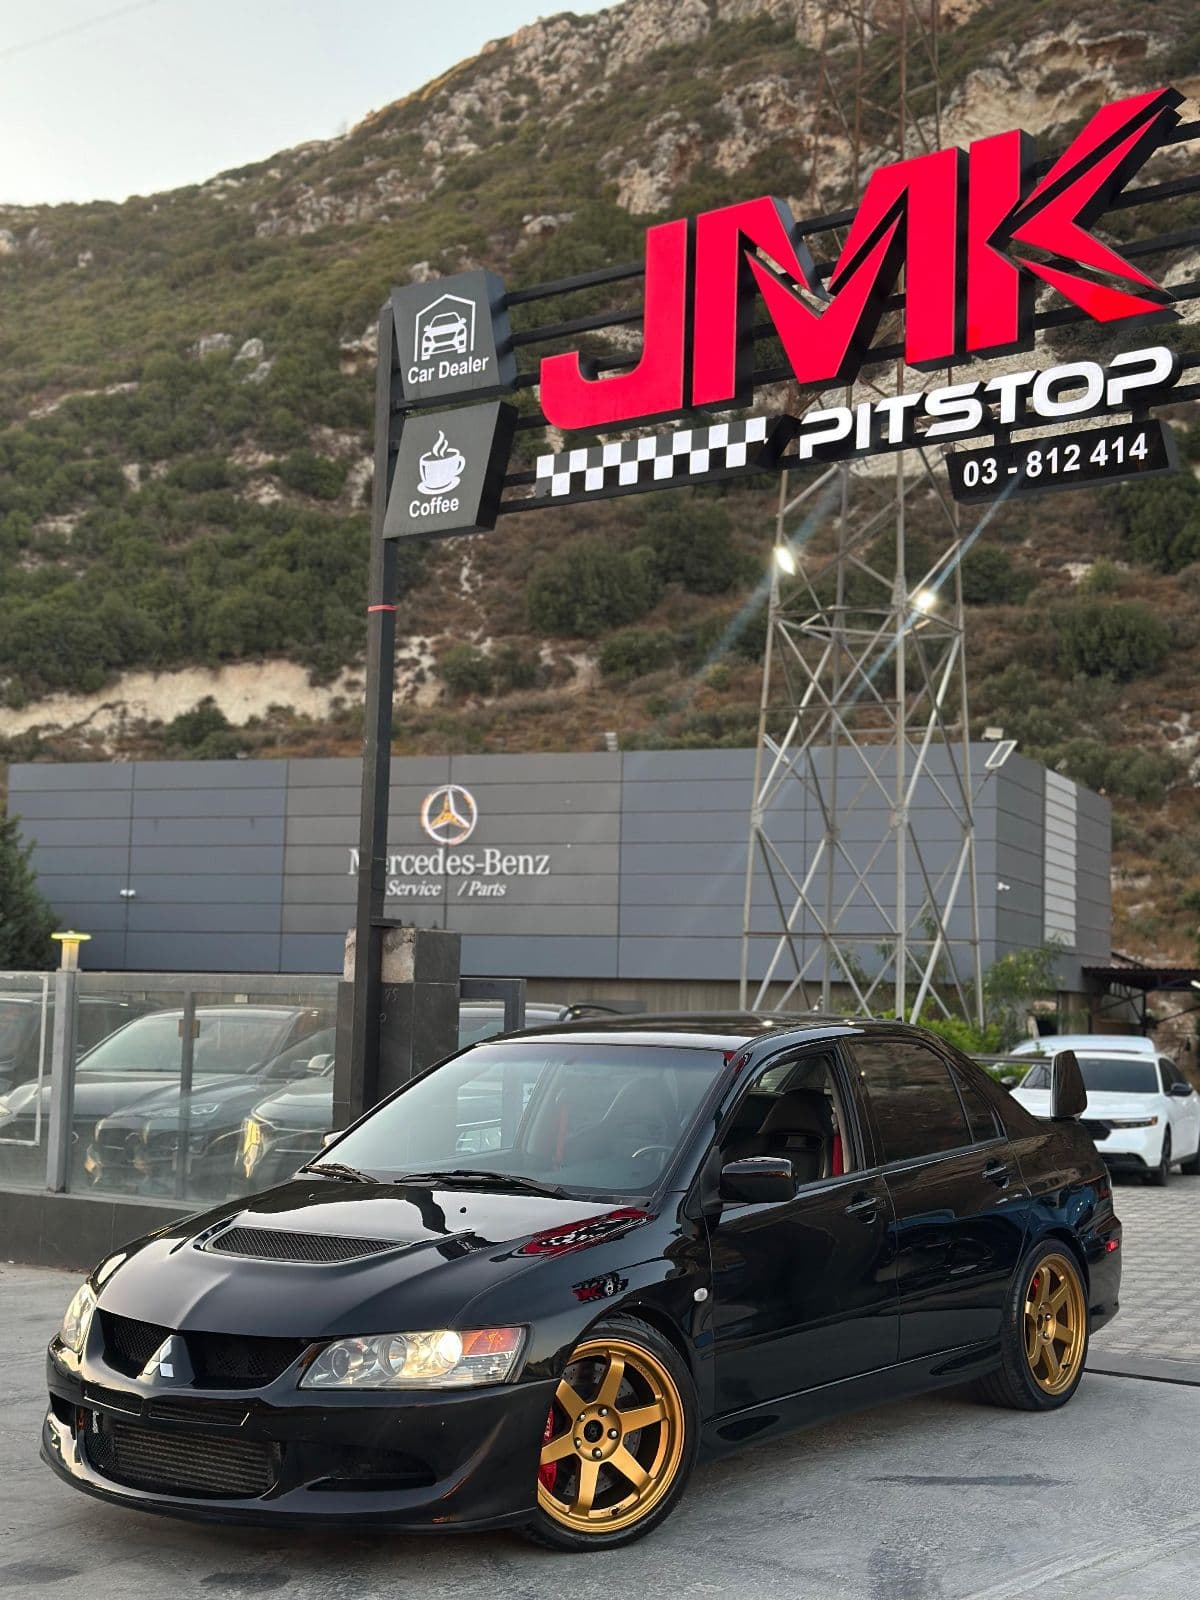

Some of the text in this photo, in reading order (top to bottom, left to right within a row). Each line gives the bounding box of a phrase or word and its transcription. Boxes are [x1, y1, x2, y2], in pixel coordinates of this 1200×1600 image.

[540, 87, 1174, 430] JMK
[407, 355, 490, 385] Car Dealer
[799, 346, 1173, 460] PITSTOP
[963, 460, 998, 488] 03
[1025, 444, 1081, 478] 812
[1089, 432, 1149, 467] 414
[408, 496, 460, 518] Coffee
[348, 848, 551, 875] rcedes-Benz
[386, 880, 442, 896] Service
[468, 881, 507, 896] Parts
